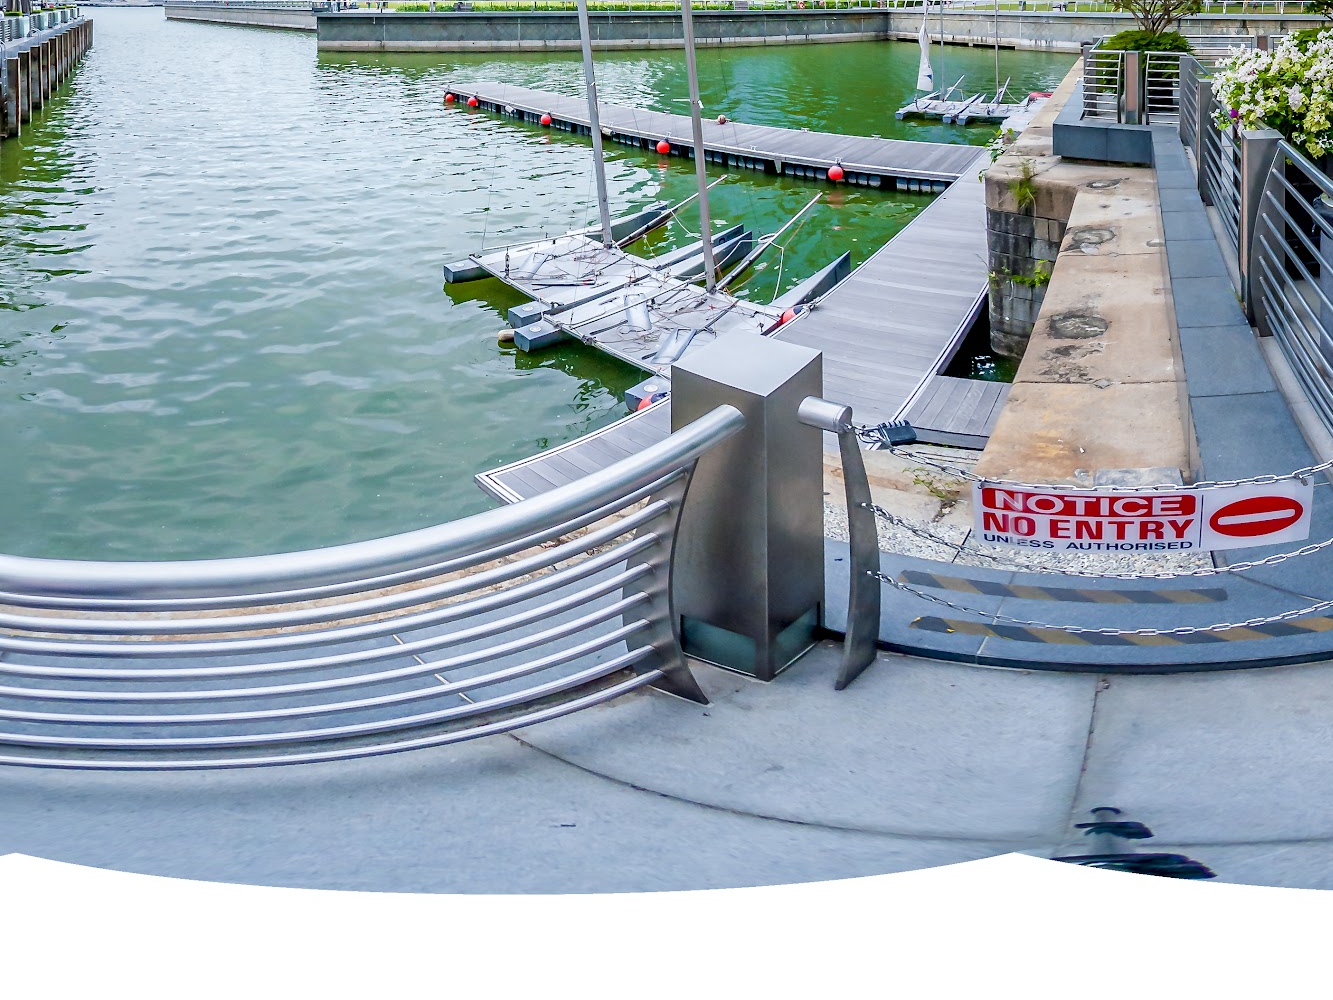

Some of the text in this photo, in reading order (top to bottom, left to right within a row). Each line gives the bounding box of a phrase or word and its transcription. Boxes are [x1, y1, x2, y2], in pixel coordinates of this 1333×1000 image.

[994, 489, 1183, 516] NOTICE
[983, 511, 1195, 541] NO ENTRY
[984, 533, 1194, 551] UNLESS AUTHORISED
